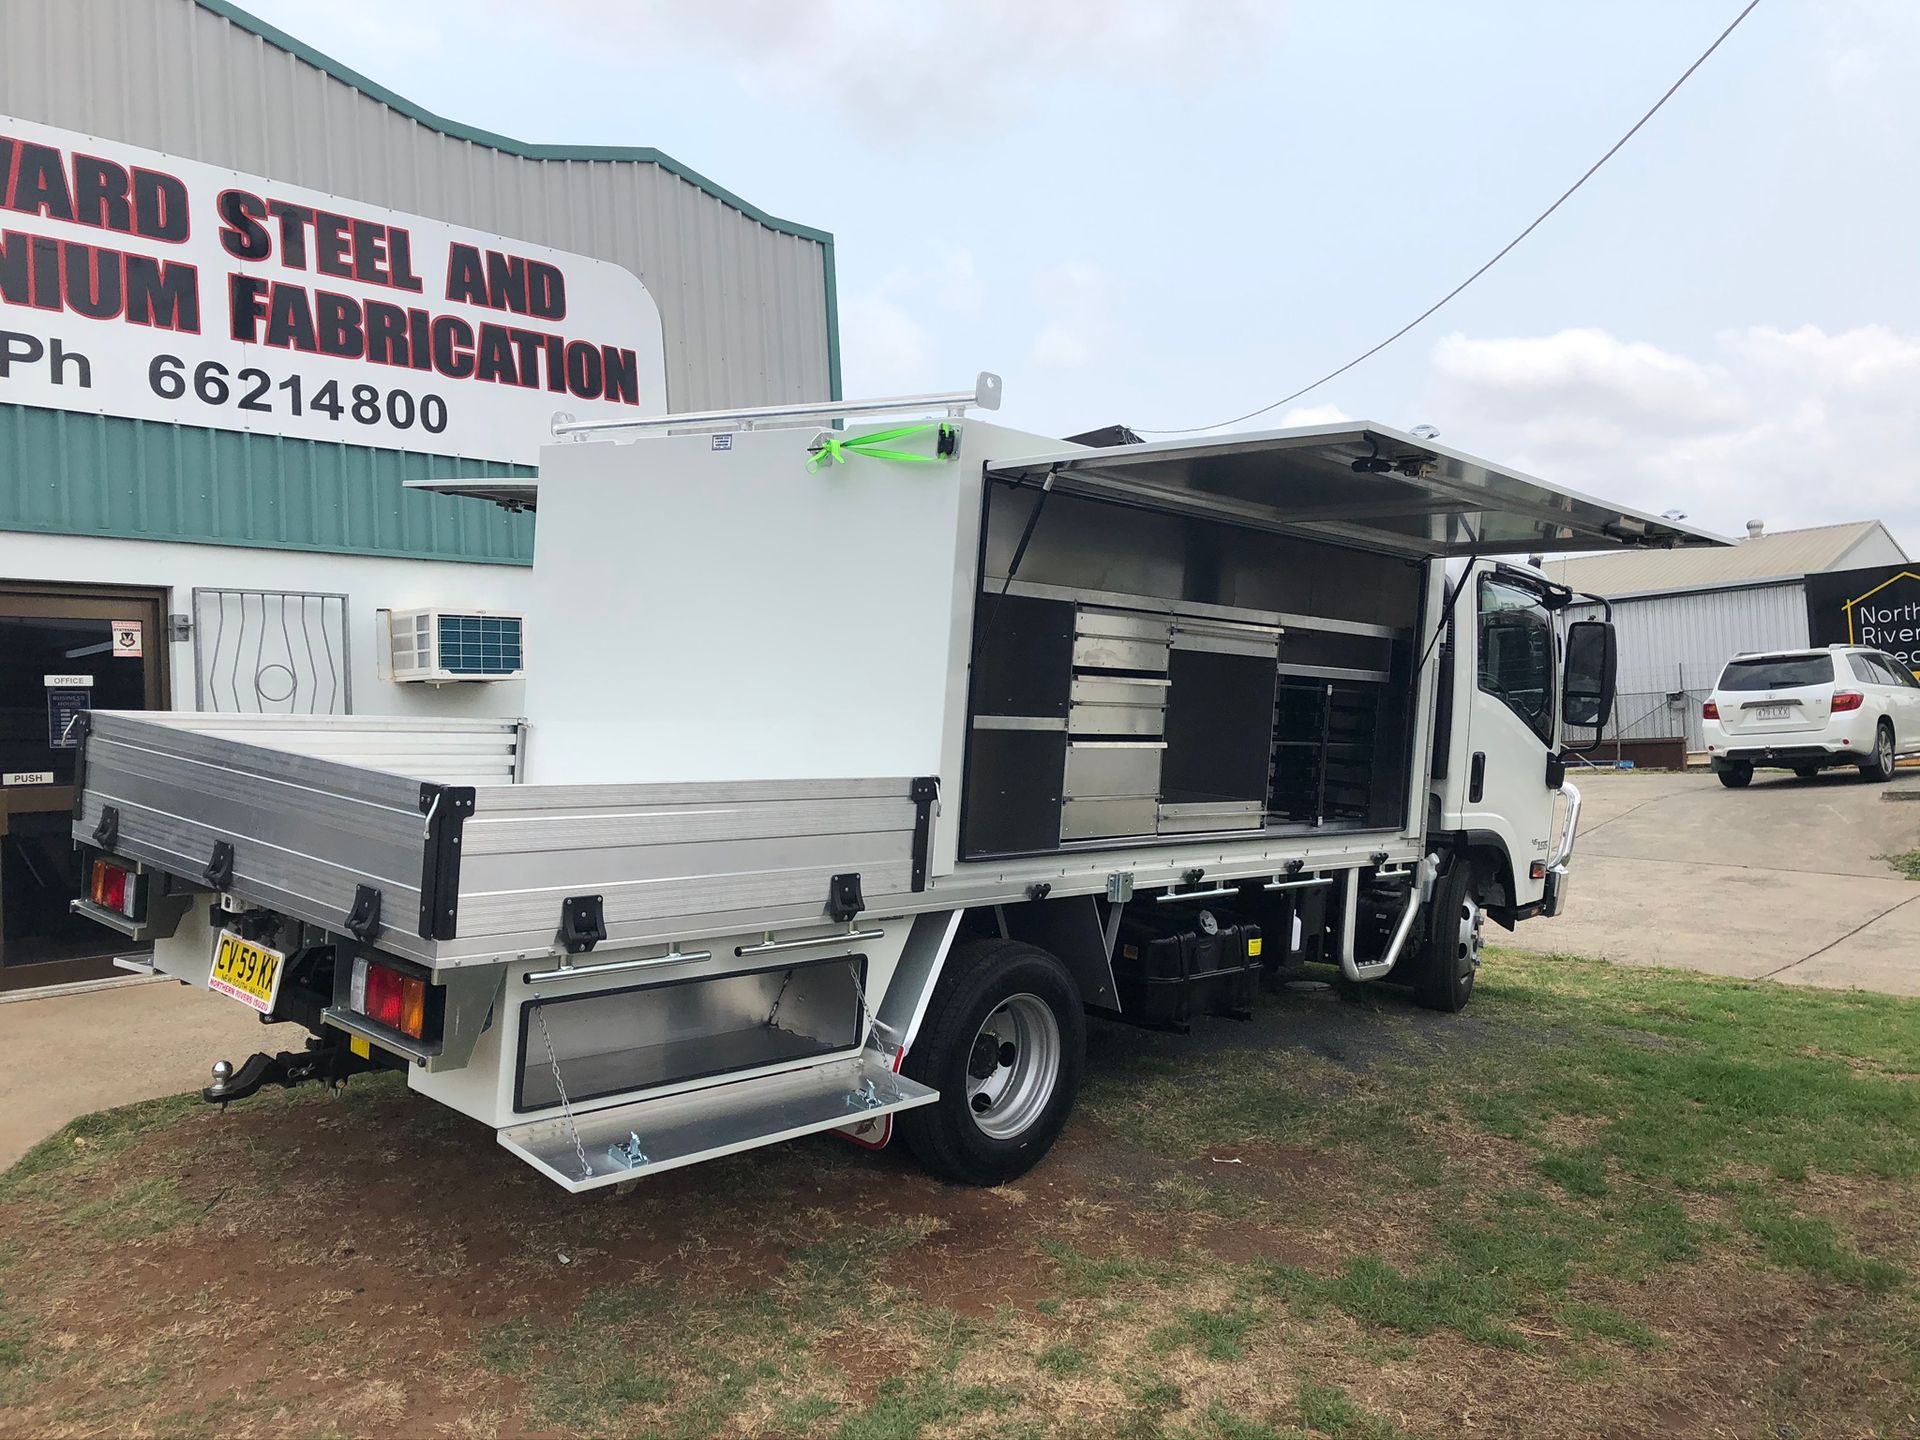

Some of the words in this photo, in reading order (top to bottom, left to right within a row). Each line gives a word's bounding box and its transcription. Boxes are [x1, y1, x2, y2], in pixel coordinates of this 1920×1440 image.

[216, 189, 423, 293] STEEL
[445, 241, 566, 321] AND
[0, 330, 92, 389] Ph
[148, 354, 447, 433] 66214800
[228, 272, 639, 406] FABRICATION
[14, 774, 43, 783] PUSH
